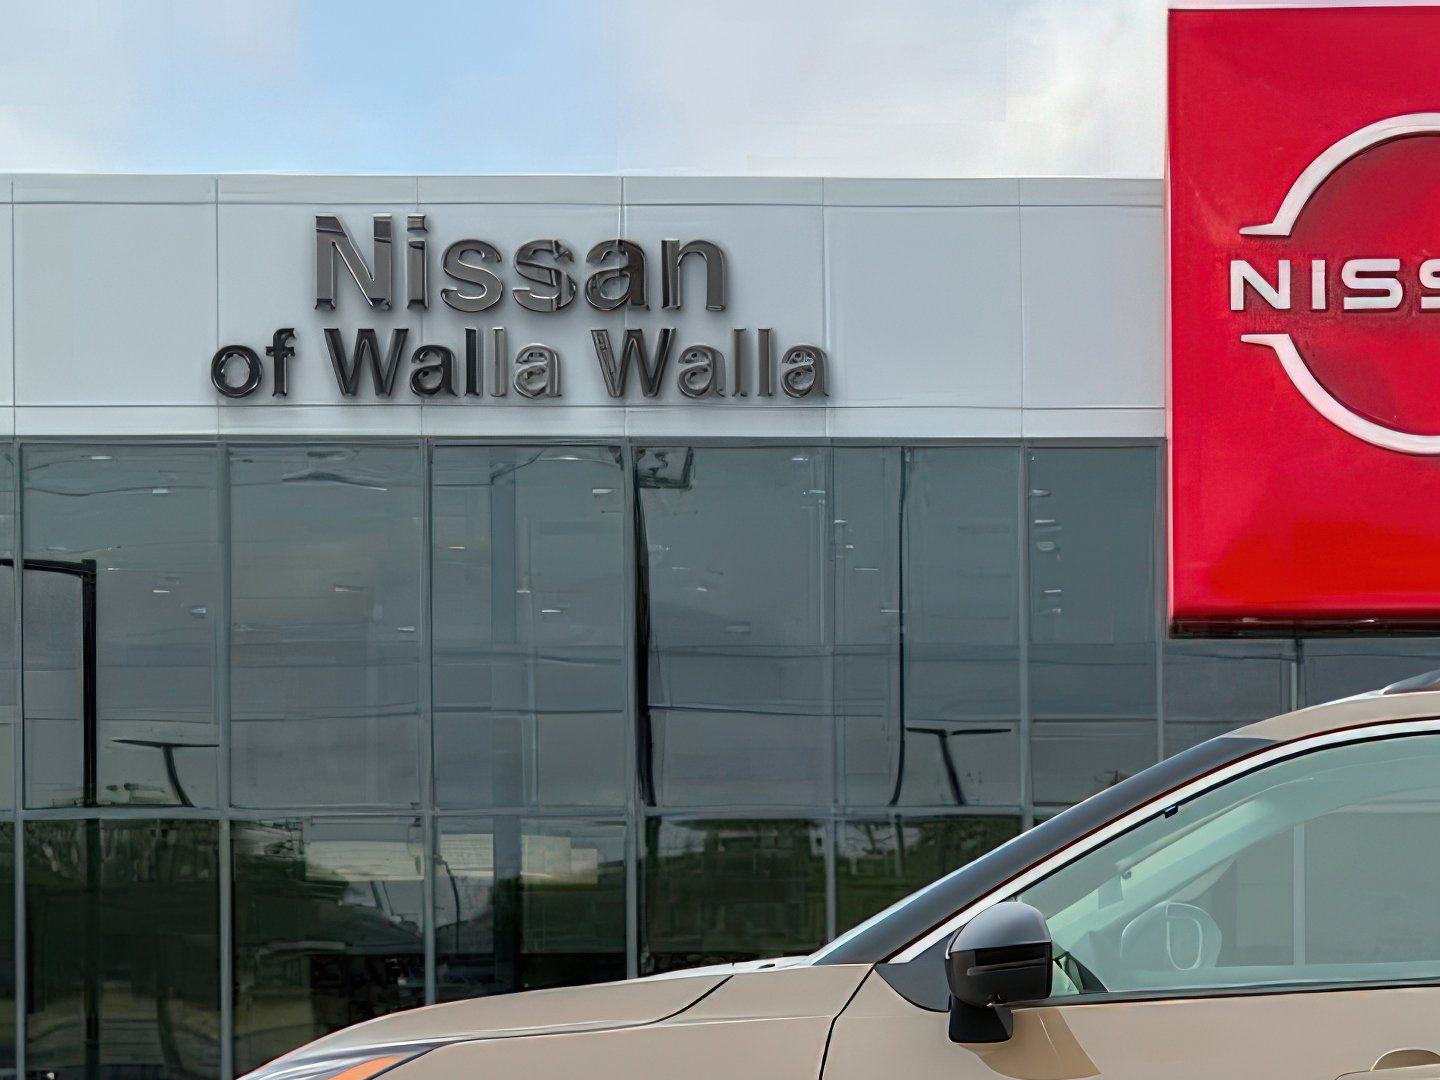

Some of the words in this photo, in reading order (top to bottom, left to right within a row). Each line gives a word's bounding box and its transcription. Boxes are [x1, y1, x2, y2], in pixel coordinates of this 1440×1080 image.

[314, 213, 727, 312] Nissan
[210, 326, 297, 398] of
[323, 326, 564, 398] Walla
[590, 326, 830, 398] Walla
